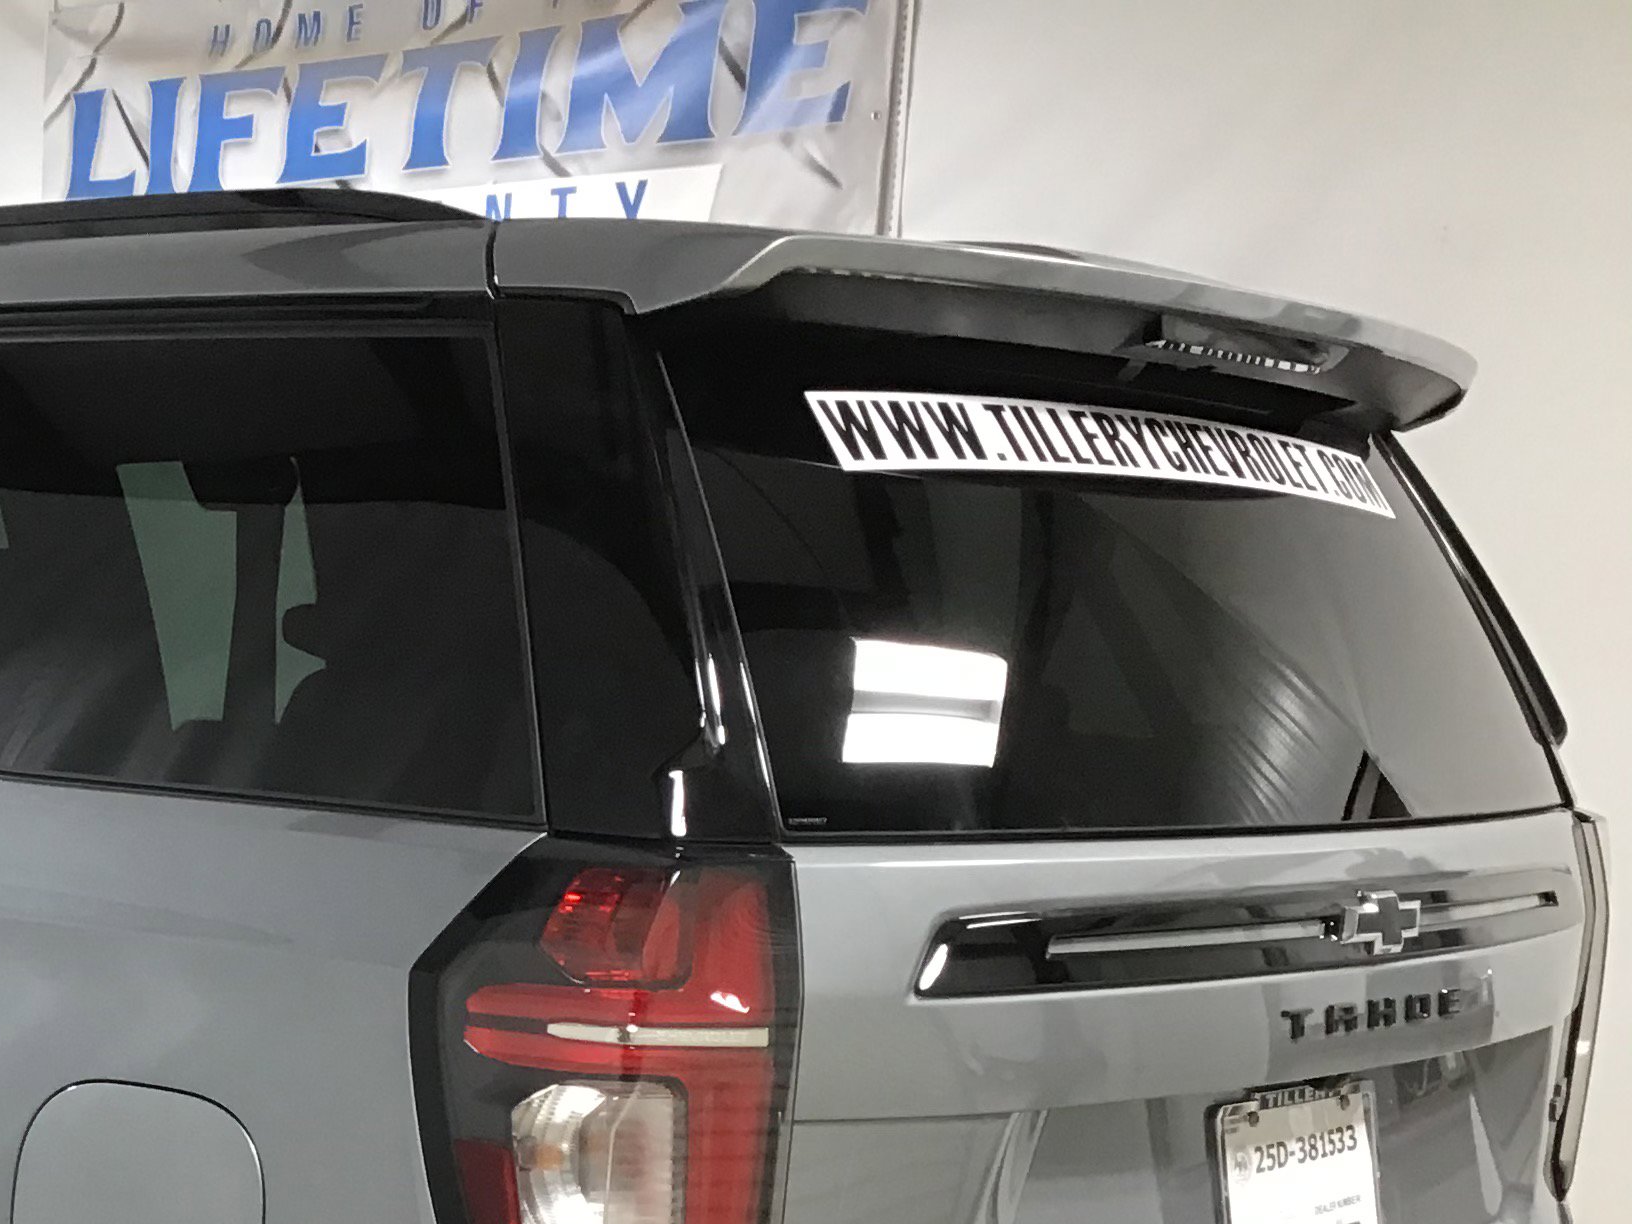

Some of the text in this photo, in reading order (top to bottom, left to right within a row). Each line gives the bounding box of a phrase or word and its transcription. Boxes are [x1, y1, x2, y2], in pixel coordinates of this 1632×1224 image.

[208, 3, 364, 58] HOME
[65, 0, 870, 199] LIFETIME
[818, 399, 1388, 511] WWW.TILLERYCHEVROLET.COM
[1280, 988, 1461, 1041] TAHOE
[1254, 1124, 1358, 1174] 25D-381533
